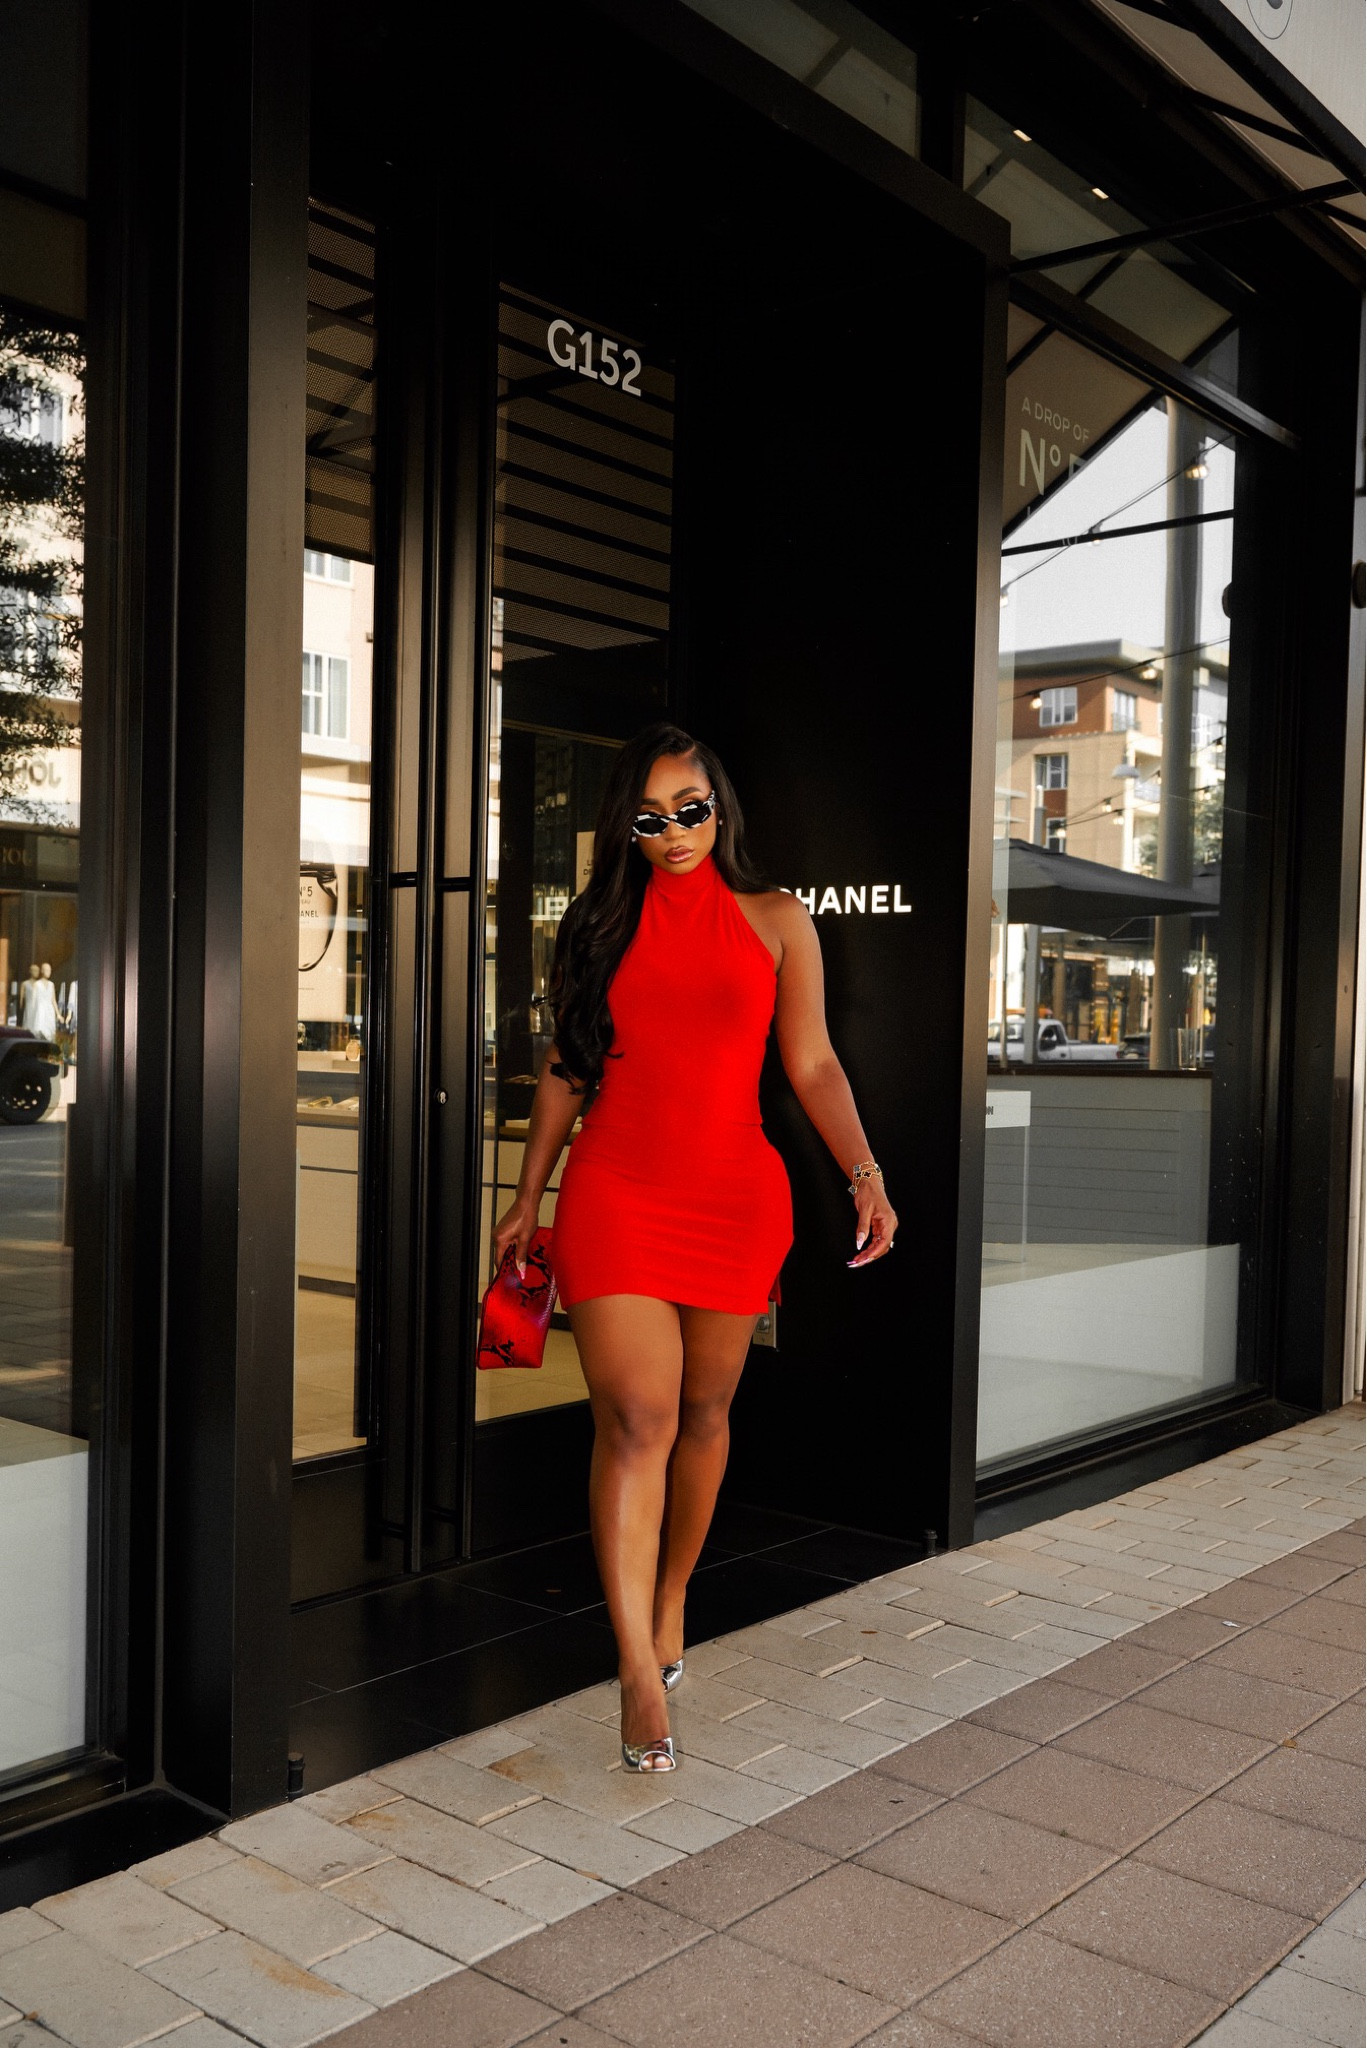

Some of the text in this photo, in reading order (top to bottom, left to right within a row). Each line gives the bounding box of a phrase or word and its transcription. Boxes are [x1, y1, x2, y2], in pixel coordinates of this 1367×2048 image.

[547, 319, 642, 397] G152
[1021, 397, 1090, 443] A DROP OF
[307, 885, 313, 897] 5
[779, 884, 912, 915] HANEL
